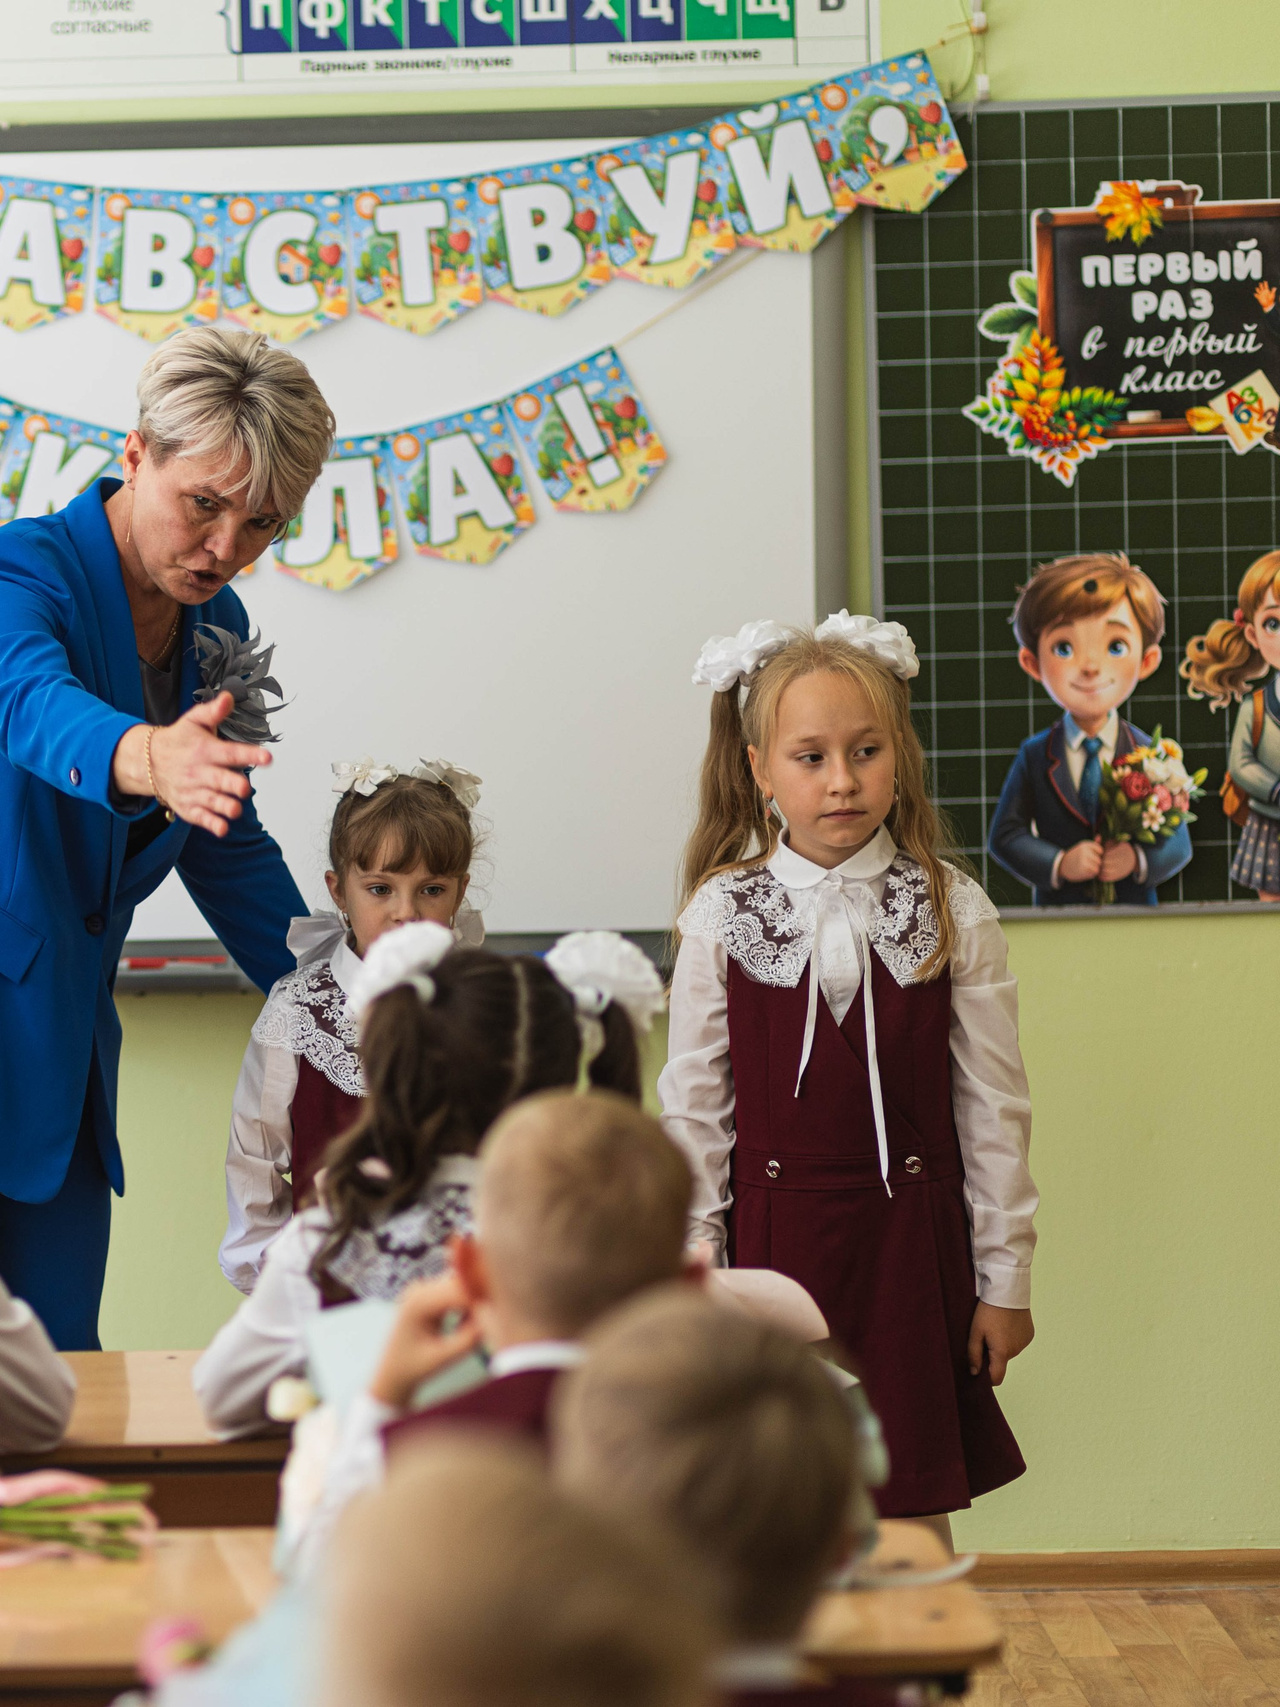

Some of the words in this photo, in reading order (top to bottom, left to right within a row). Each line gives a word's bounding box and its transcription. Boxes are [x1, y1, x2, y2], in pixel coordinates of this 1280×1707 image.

[299, 0, 345, 38] ф
[361, 0, 394, 26] к
[1081, 238, 1263, 288] ПЕРВЫЙ
[1131, 288, 1215, 323] РАЗ
[1081, 325, 1107, 360] в
[1123, 322, 1263, 368] первый
[1120, 365, 1225, 394] класс
